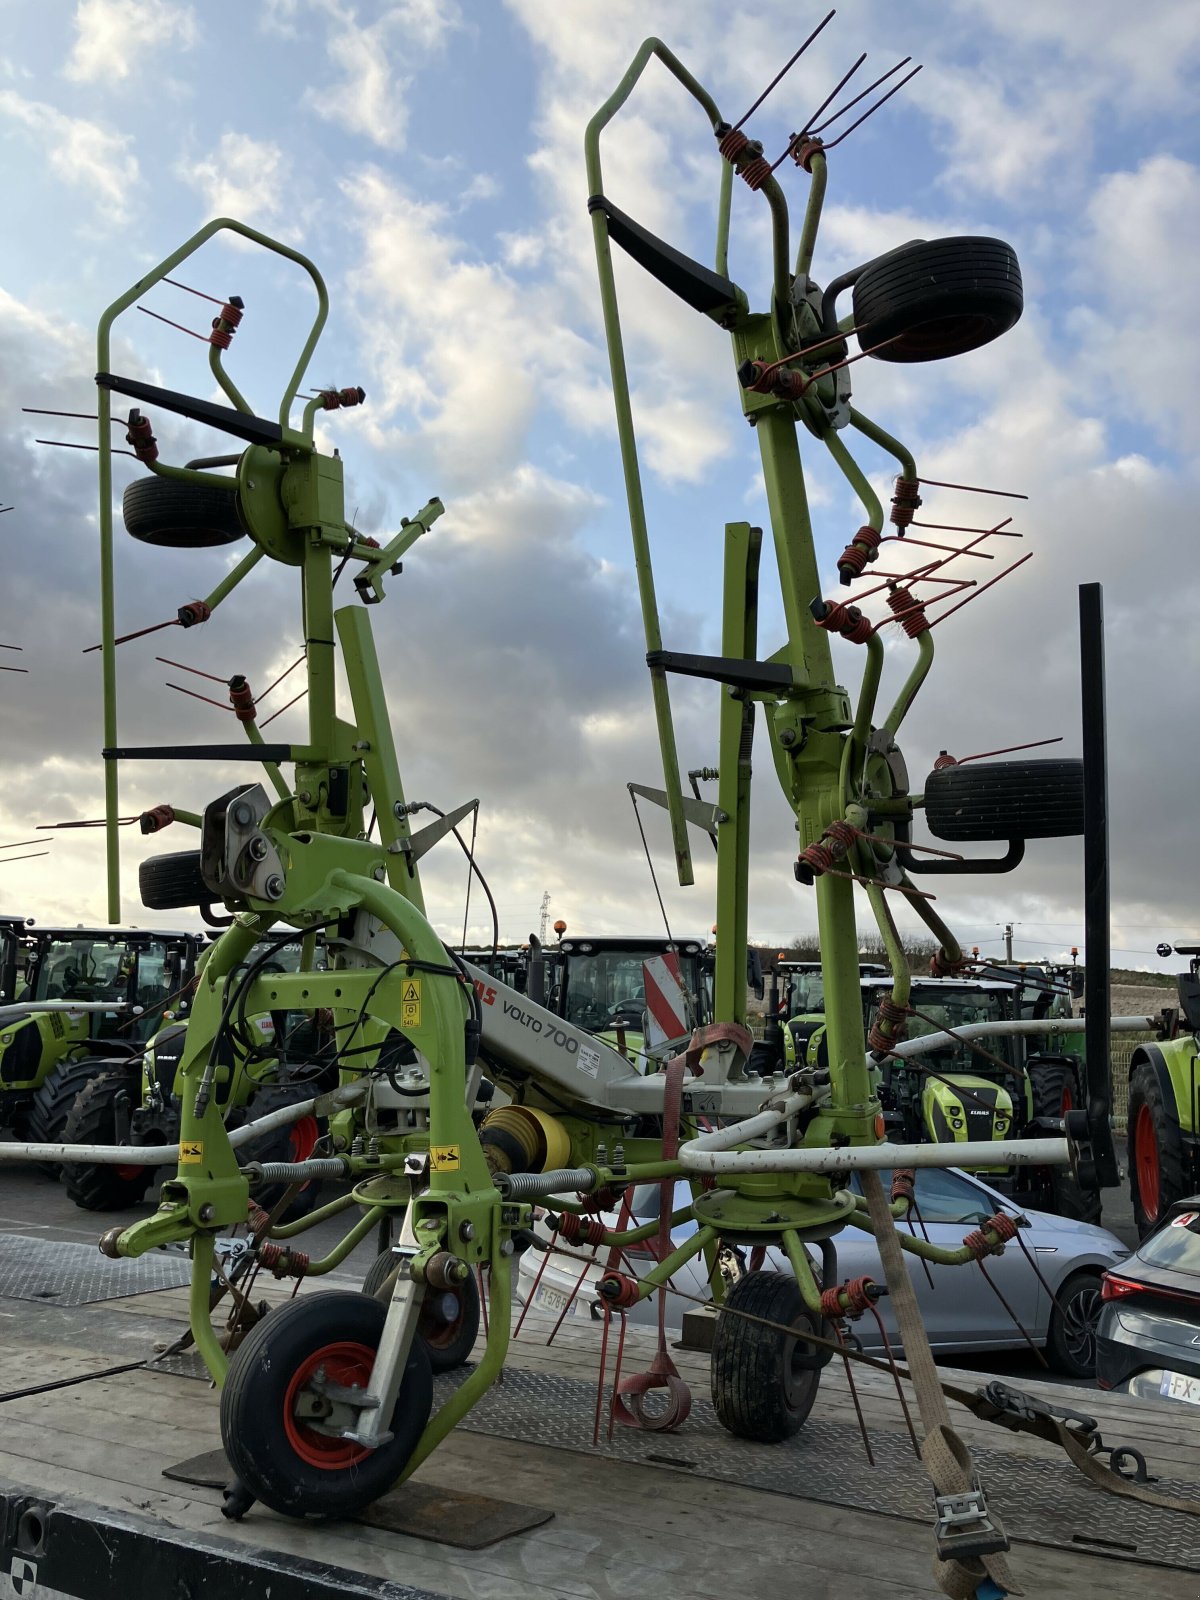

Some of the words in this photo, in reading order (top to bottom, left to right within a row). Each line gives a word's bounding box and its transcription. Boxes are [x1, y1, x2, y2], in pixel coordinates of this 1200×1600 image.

[503, 1001, 542, 1033] VOLTO
[543, 1023, 578, 1054] 700
[1172, 1376, 1200, 1401] FX-
